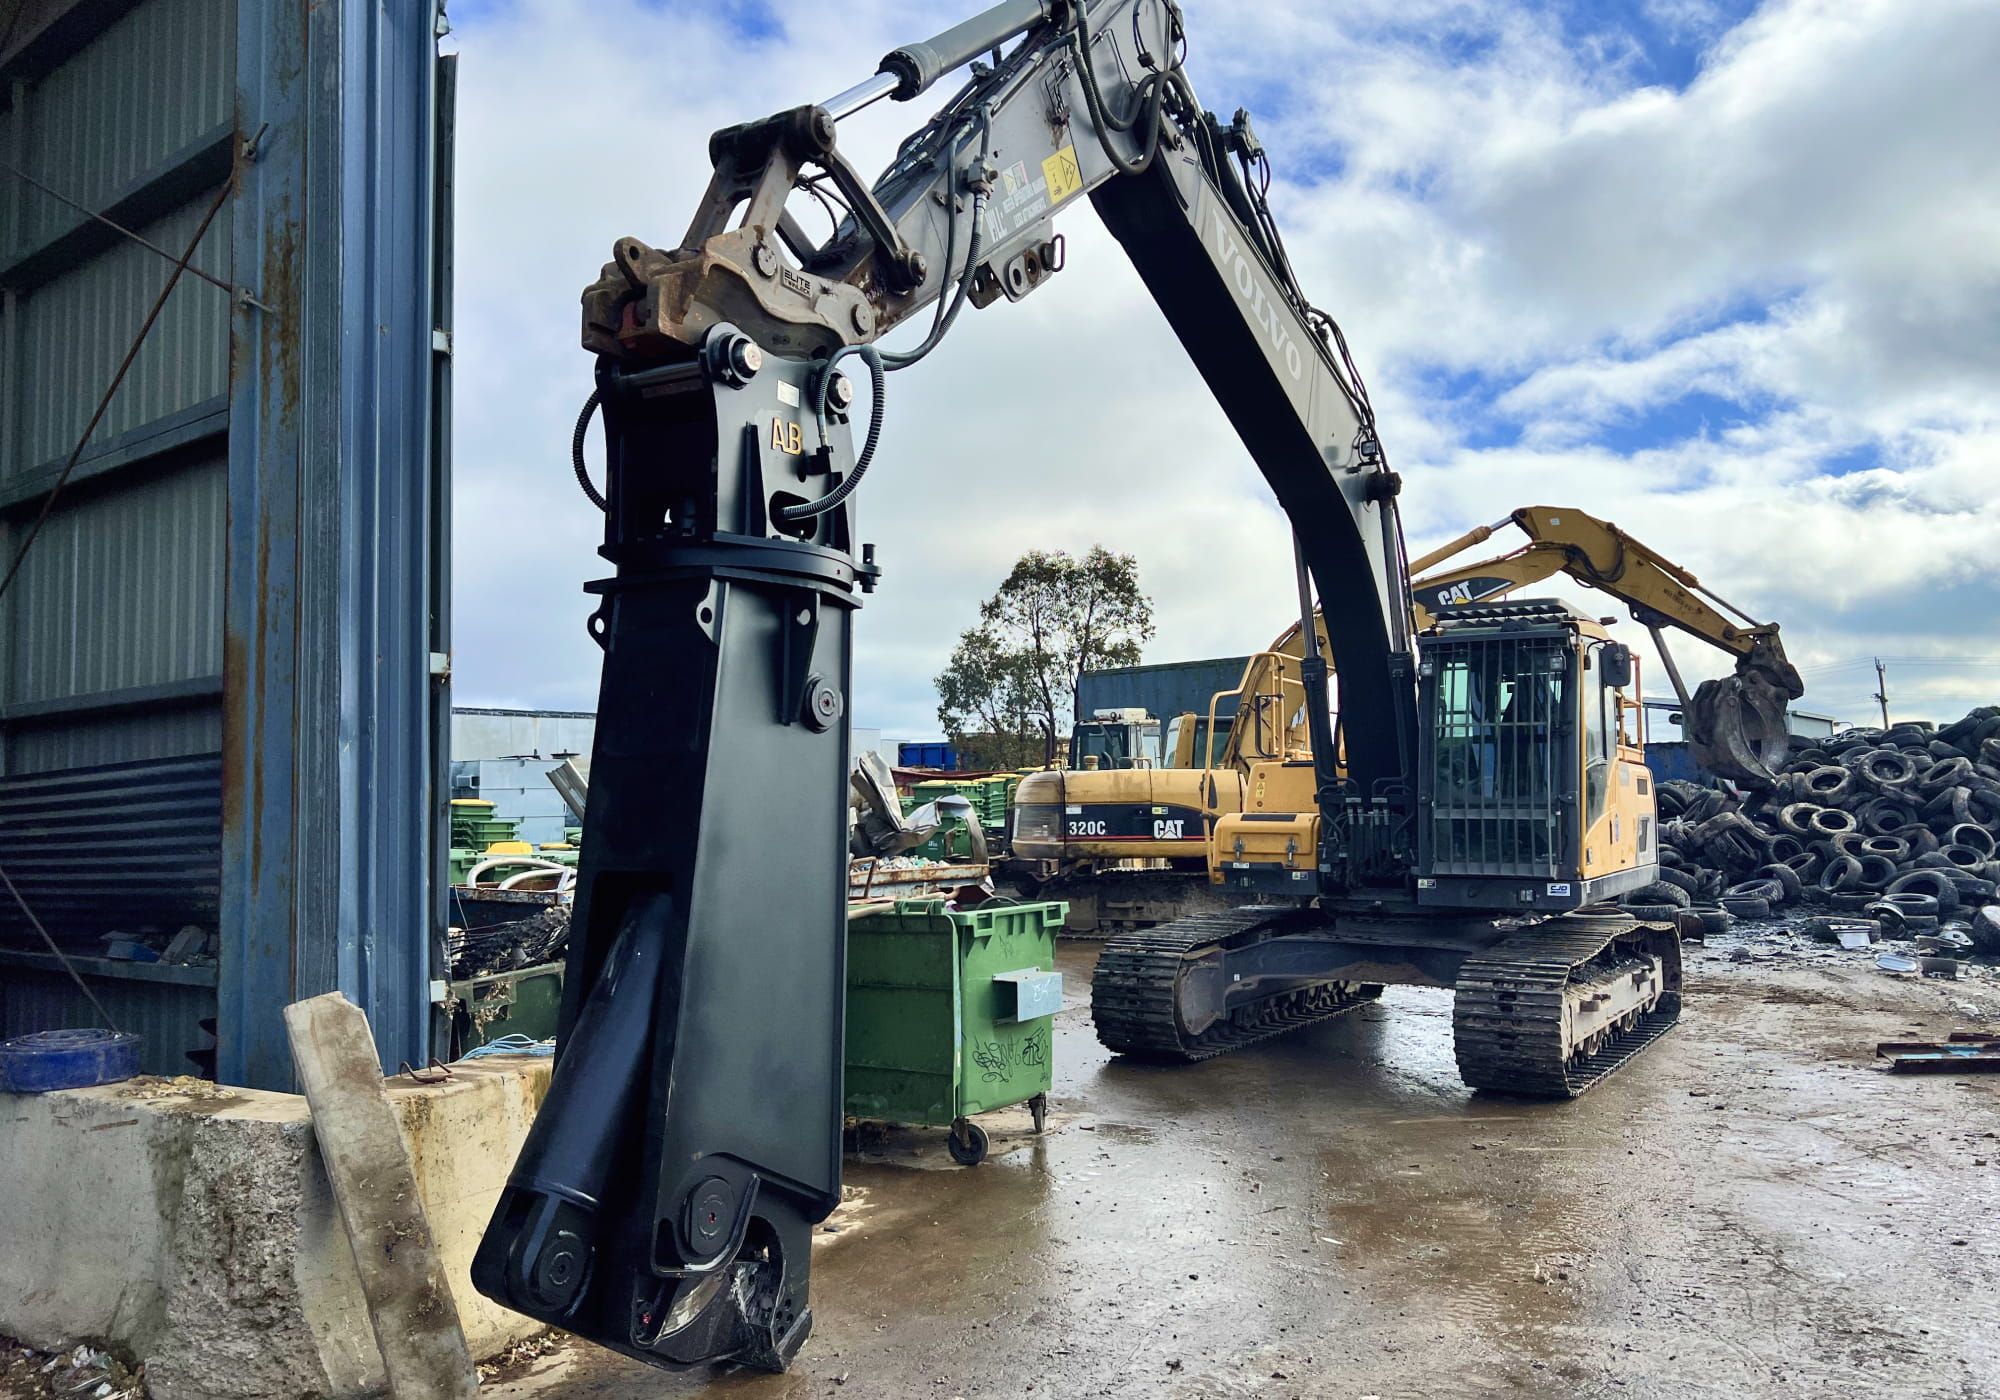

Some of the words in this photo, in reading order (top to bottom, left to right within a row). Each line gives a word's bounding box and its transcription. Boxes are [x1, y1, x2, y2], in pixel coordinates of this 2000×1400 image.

[784, 269, 811, 290] ELITE
[1213, 208, 1301, 381] VOLVO
[771, 417, 802, 455] AB
[1438, 581, 1474, 605] CAT
[1068, 820, 1106, 836] 320C
[1153, 819, 1185, 839] CAT
